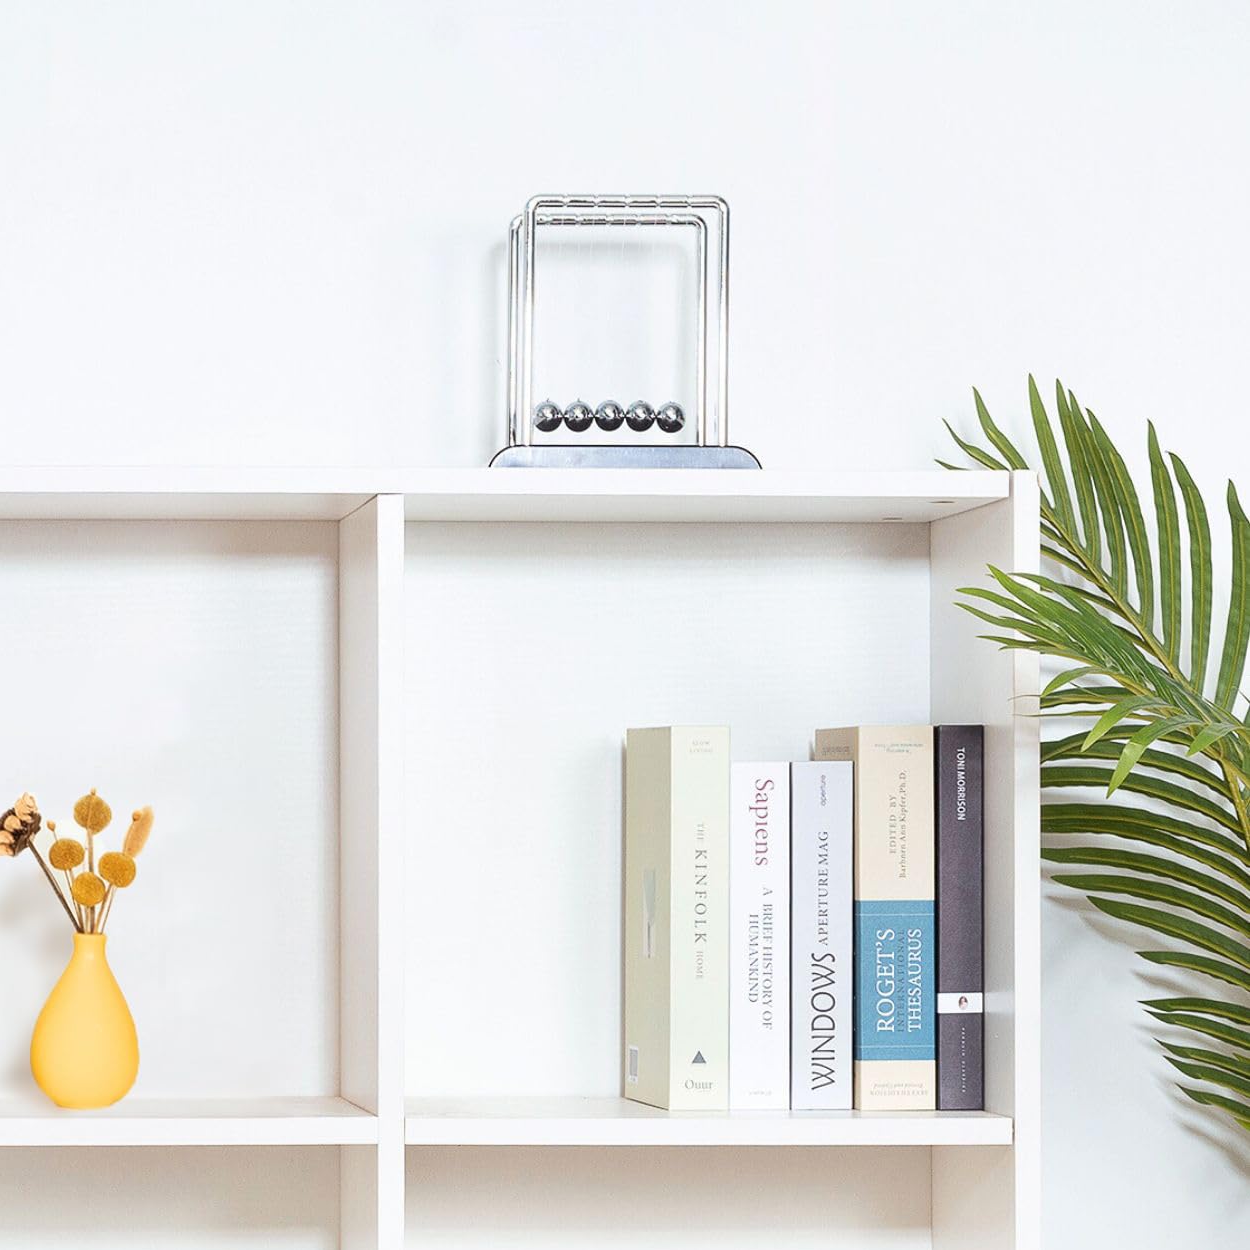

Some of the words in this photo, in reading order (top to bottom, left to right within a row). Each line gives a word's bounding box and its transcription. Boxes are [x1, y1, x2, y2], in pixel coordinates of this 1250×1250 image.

[956, 747, 966, 770] TONI
[819, 774, 827, 807] aperture
[889, 794, 897, 808] BY
[956, 771, 966, 821] MORRISON
[749, 778, 775, 866] Sapiens
[889, 814, 897, 854] EDITED
[817, 830, 829, 866] MAG
[695, 849, 707, 944] KINFOLK
[763, 887, 773, 897] A
[817, 868, 829, 946] APERTURE
[762, 903, 773, 944] BRIEF
[696, 950, 704, 980] HOME
[748, 913, 759, 1003] HUMANKIND
[762, 946, 773, 1008] HISTORY
[875, 928, 895, 1033] ROGET'S
[896, 929, 905, 1032] INTERNATIONAL
[907, 928, 922, 1033] THESAURUS
[762, 1010, 773, 1030] OF
[810, 952, 836, 1091] WINDOWS
[684, 1079, 713, 1089] Ouur
